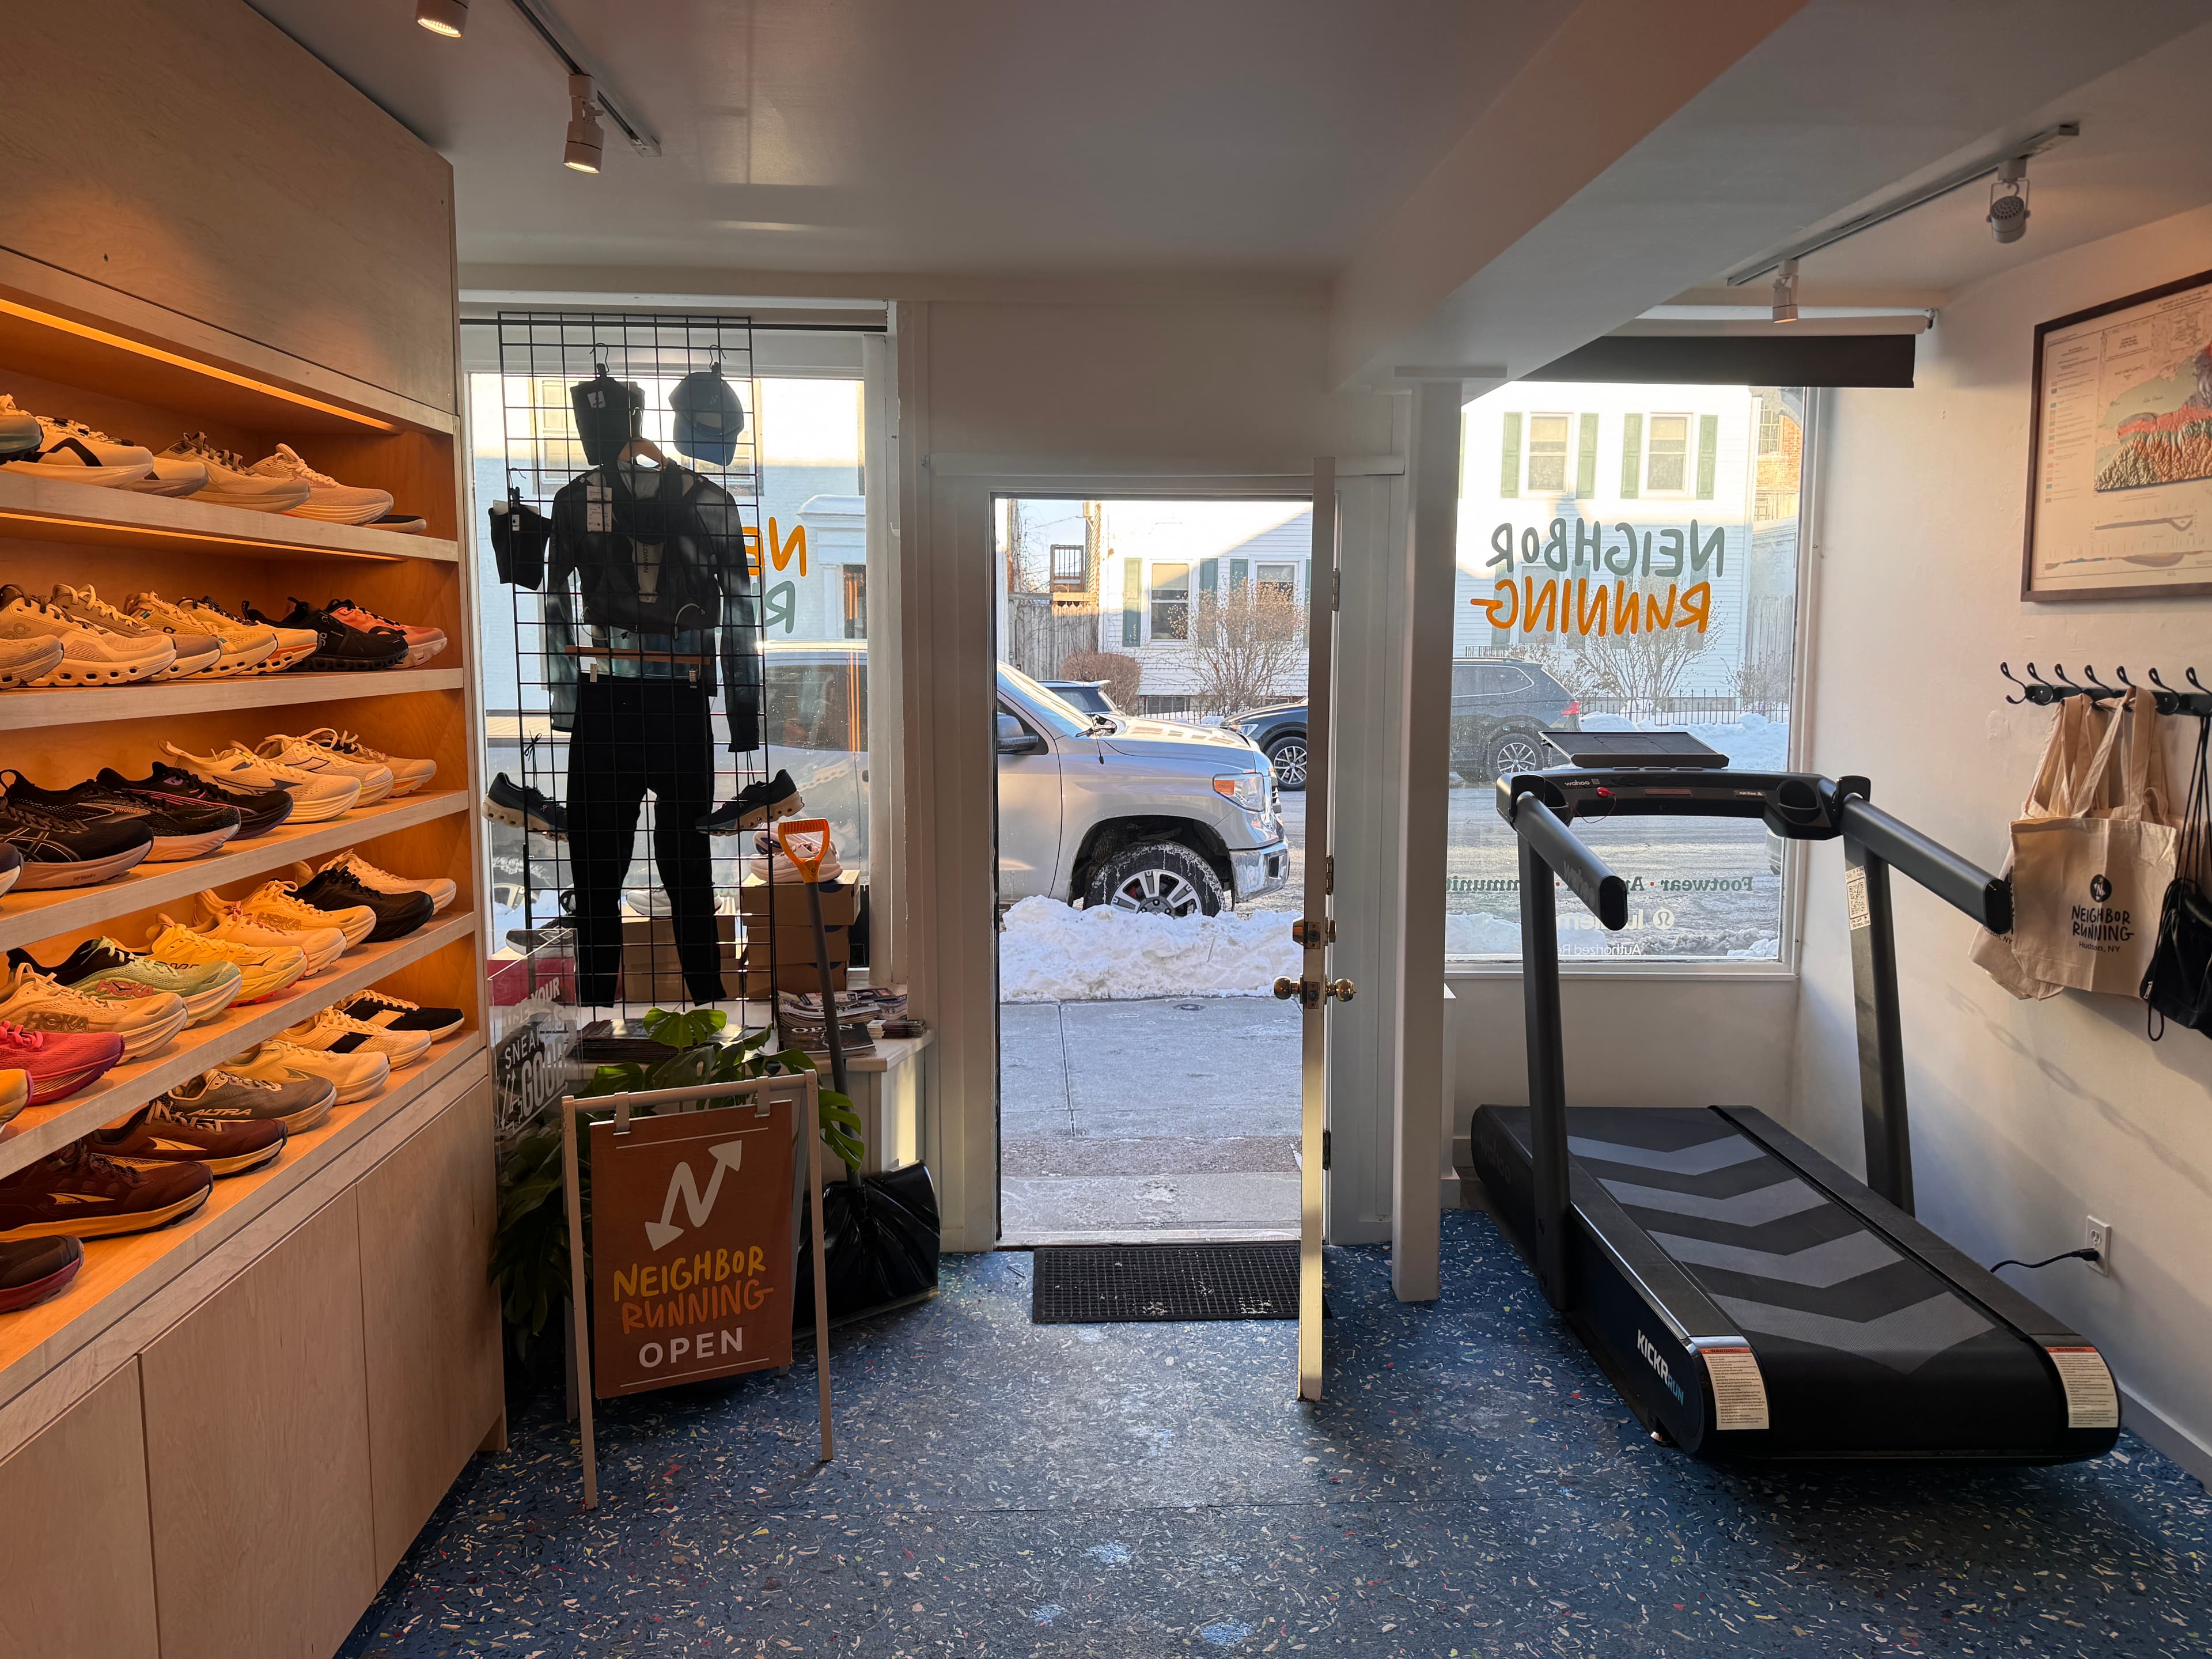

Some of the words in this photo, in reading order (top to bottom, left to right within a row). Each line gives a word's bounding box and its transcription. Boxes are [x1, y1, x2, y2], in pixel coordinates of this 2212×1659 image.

[2071, 904, 2131, 925] NEIGHBOR
[2073, 922, 2134, 942] RUNNING
[2078, 941, 2105, 952] Hudson,
[2108, 945, 2120, 953] NY
[96, 978, 154, 998] HOKA
[23, 1011, 90, 1033] HOKA
[791, 1024, 855, 1033] OPN
[521, 1035, 567, 1116] GOOD
[186, 1108, 252, 1116] ALTRA
[613, 1245, 766, 1302] NEIGHBOR
[622, 1279, 774, 1335] RUNNING
[639, 1327, 743, 1368] OPEN
[1637, 1328, 1669, 1385] KICKR
[1667, 1373, 1684, 1406] RUN
